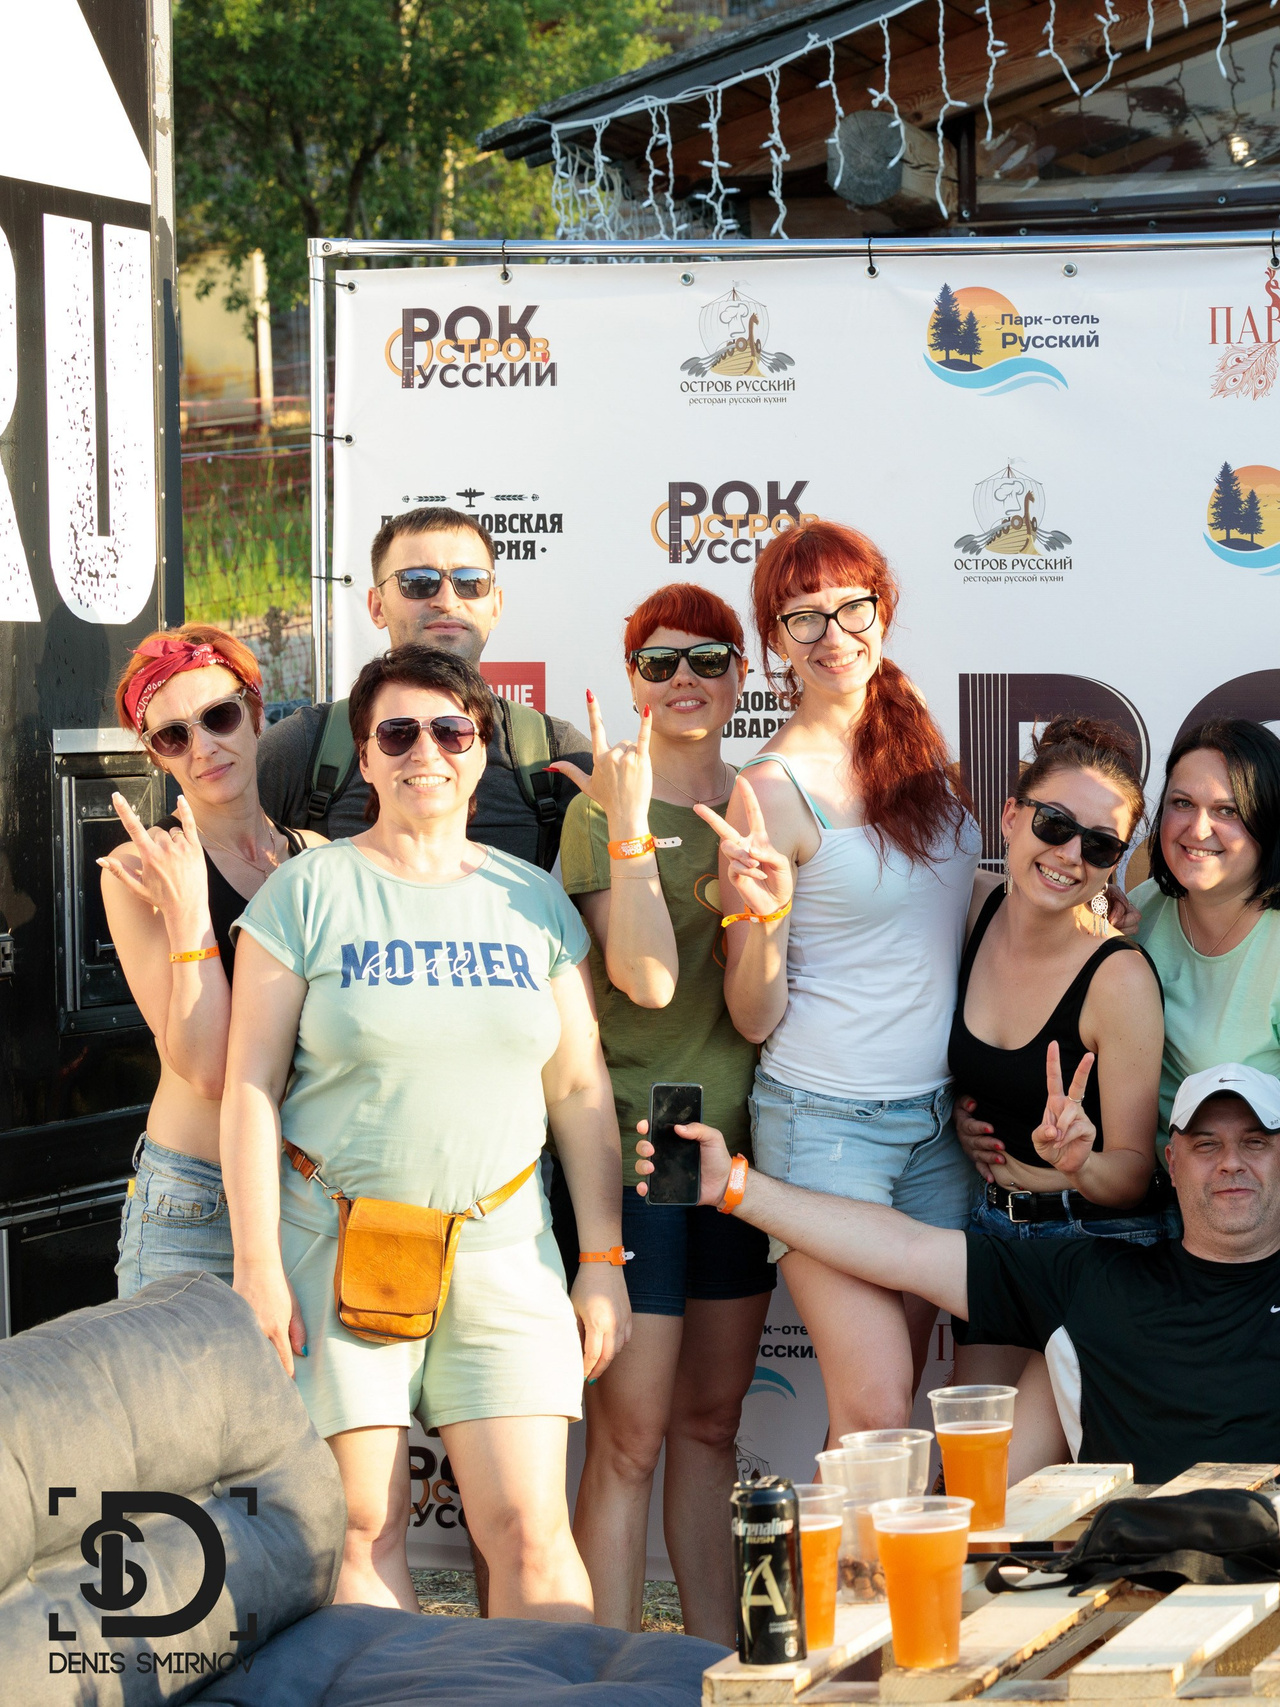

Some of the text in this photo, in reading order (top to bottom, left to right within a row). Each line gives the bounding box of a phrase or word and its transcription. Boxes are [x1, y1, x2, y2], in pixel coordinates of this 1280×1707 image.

[1001, 313, 1100, 327] Парк-отель
[402, 305, 540, 354] РОК
[1001, 330, 1099, 352] Русский
[680, 377, 796, 393] ОСТРОВ РУССКИЙ
[688, 395, 787, 406] ресторан русской кухни
[668, 480, 810, 528] РОК
[954, 556, 1073, 570] ОСТРОВ РУССКИЙ
[963, 574, 1064, 584] ресторан русской кухни
[340, 939, 541, 992] MOTHER
[732, 1517, 794, 1536] Adrenaline
